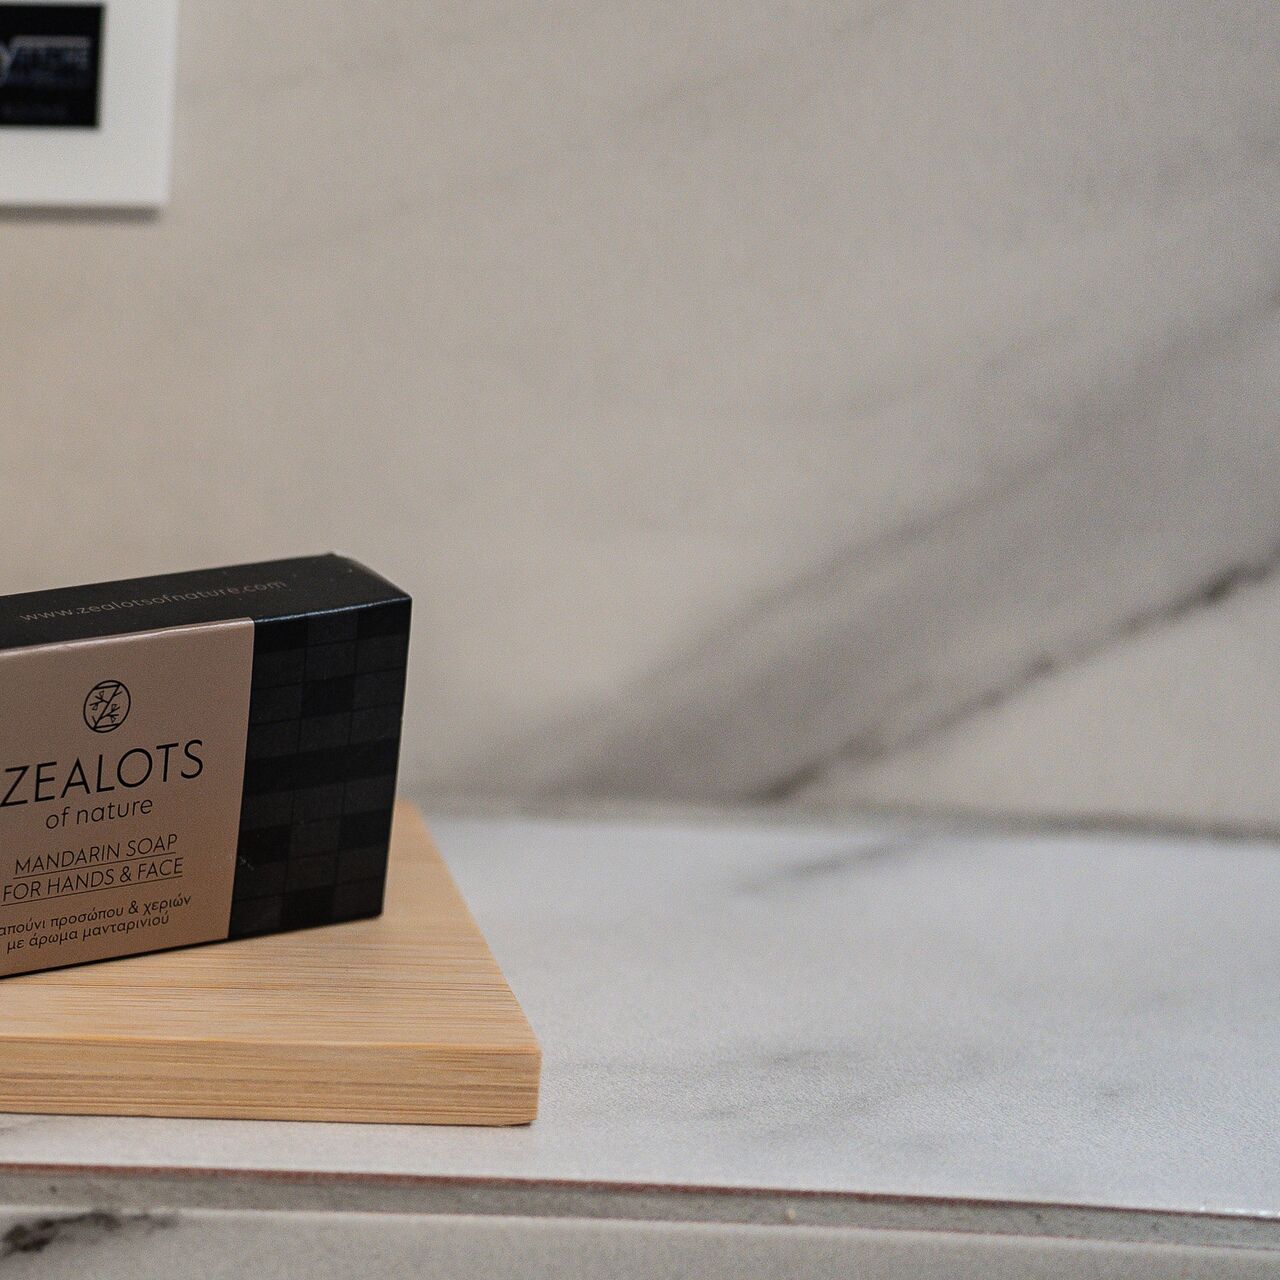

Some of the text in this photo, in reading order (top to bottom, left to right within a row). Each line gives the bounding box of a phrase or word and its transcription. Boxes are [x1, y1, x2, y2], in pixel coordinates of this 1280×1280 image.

[20, 580, 287, 622] www.zealotsofnature.com
[0, 739, 203, 808] ZEALOTS
[45, 799, 153, 829] of nature
[15, 833, 178, 875] MANDARIN SOAP
[2, 857, 184, 902] FOR HANDS & FACE
[128, 900, 139, 915] &
